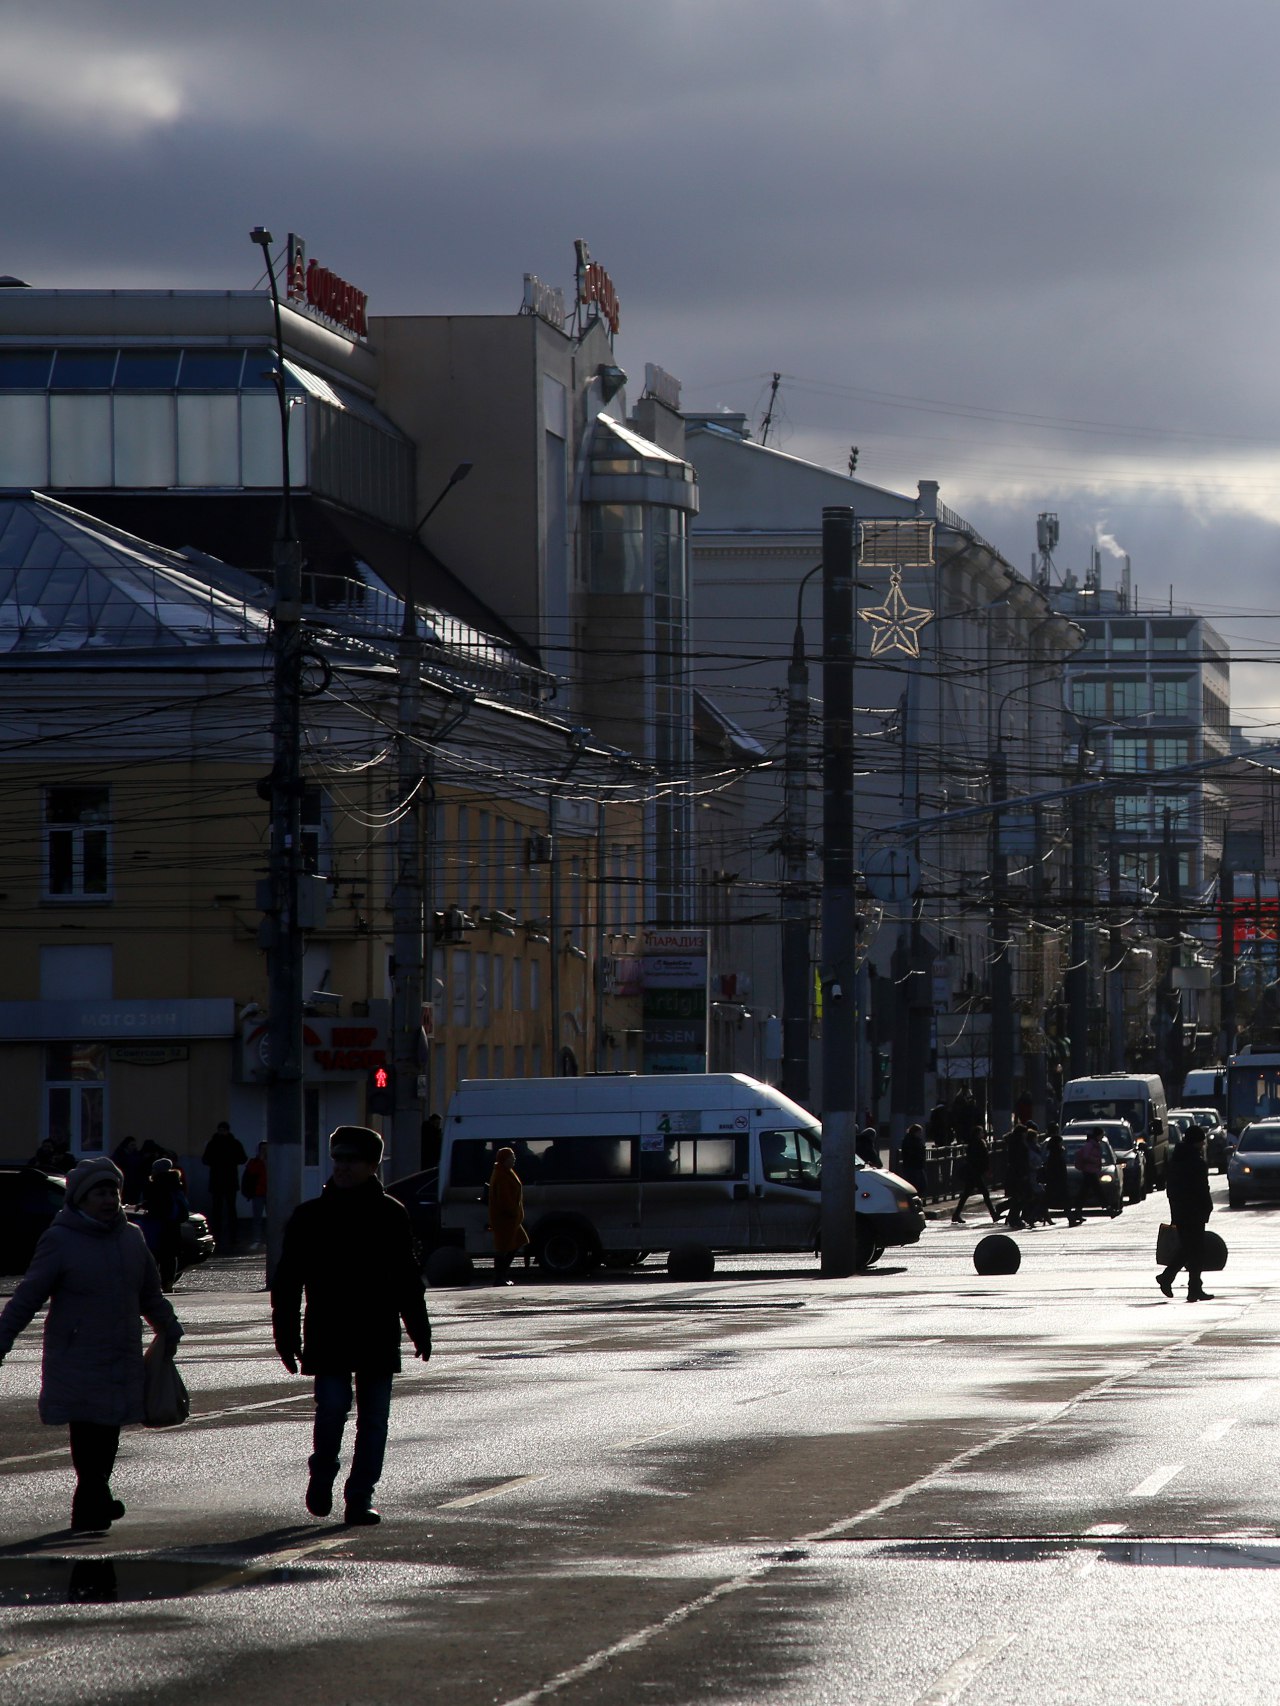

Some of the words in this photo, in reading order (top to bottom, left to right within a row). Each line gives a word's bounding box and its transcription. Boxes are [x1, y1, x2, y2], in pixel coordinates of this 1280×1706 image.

[648, 936, 705, 948] ПАРАДИЗ
[81, 1012, 177, 1027] магазин
[643, 1029, 695, 1042] OLSEN
[657, 1118, 673, 1133] 4
